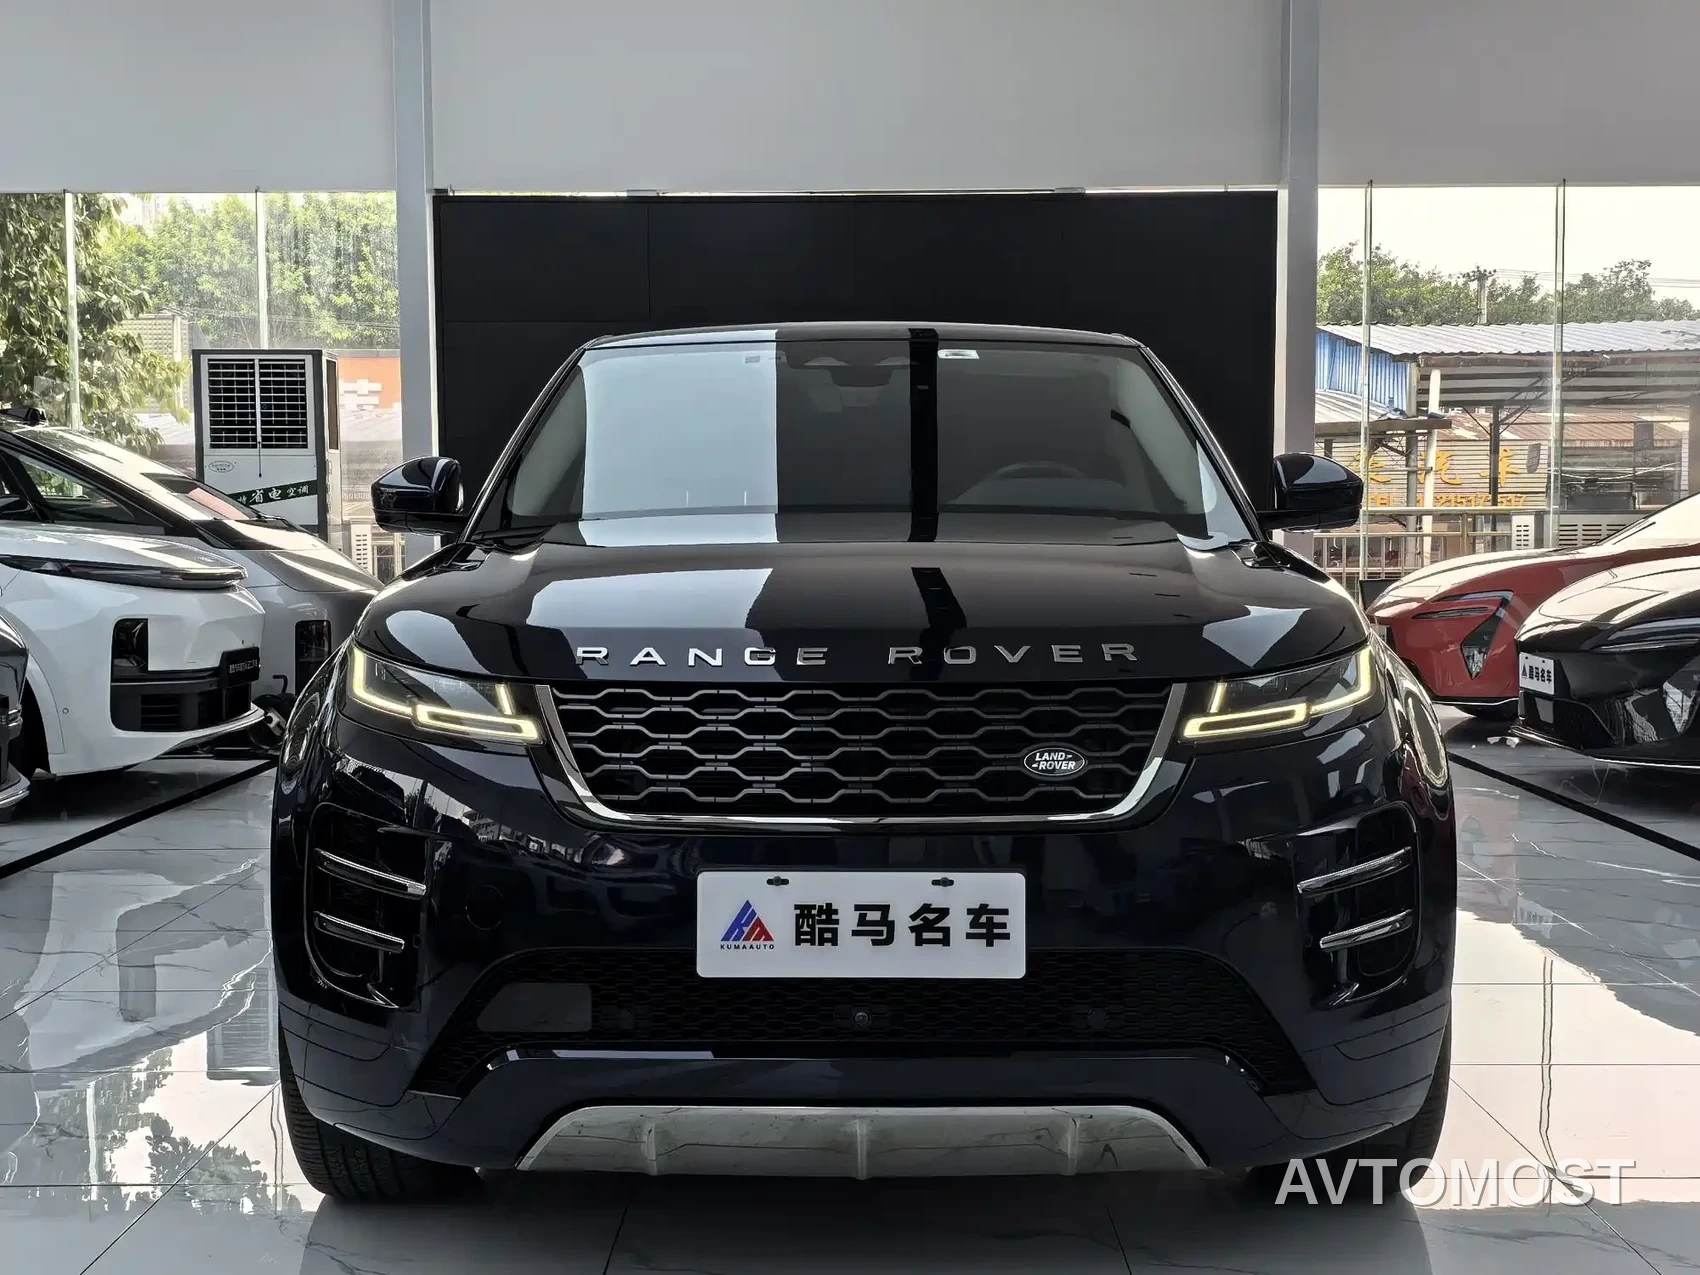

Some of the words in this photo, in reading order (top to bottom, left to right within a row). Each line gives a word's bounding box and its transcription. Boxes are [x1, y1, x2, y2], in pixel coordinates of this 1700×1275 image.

[575, 646, 828, 667] RANGE
[887, 643, 1138, 665] ROVER
[1035, 752, 1066, 761] LAND
[1038, 761, 1076, 770] ROVER
[794, 902, 1011, 947] 酷马名车
